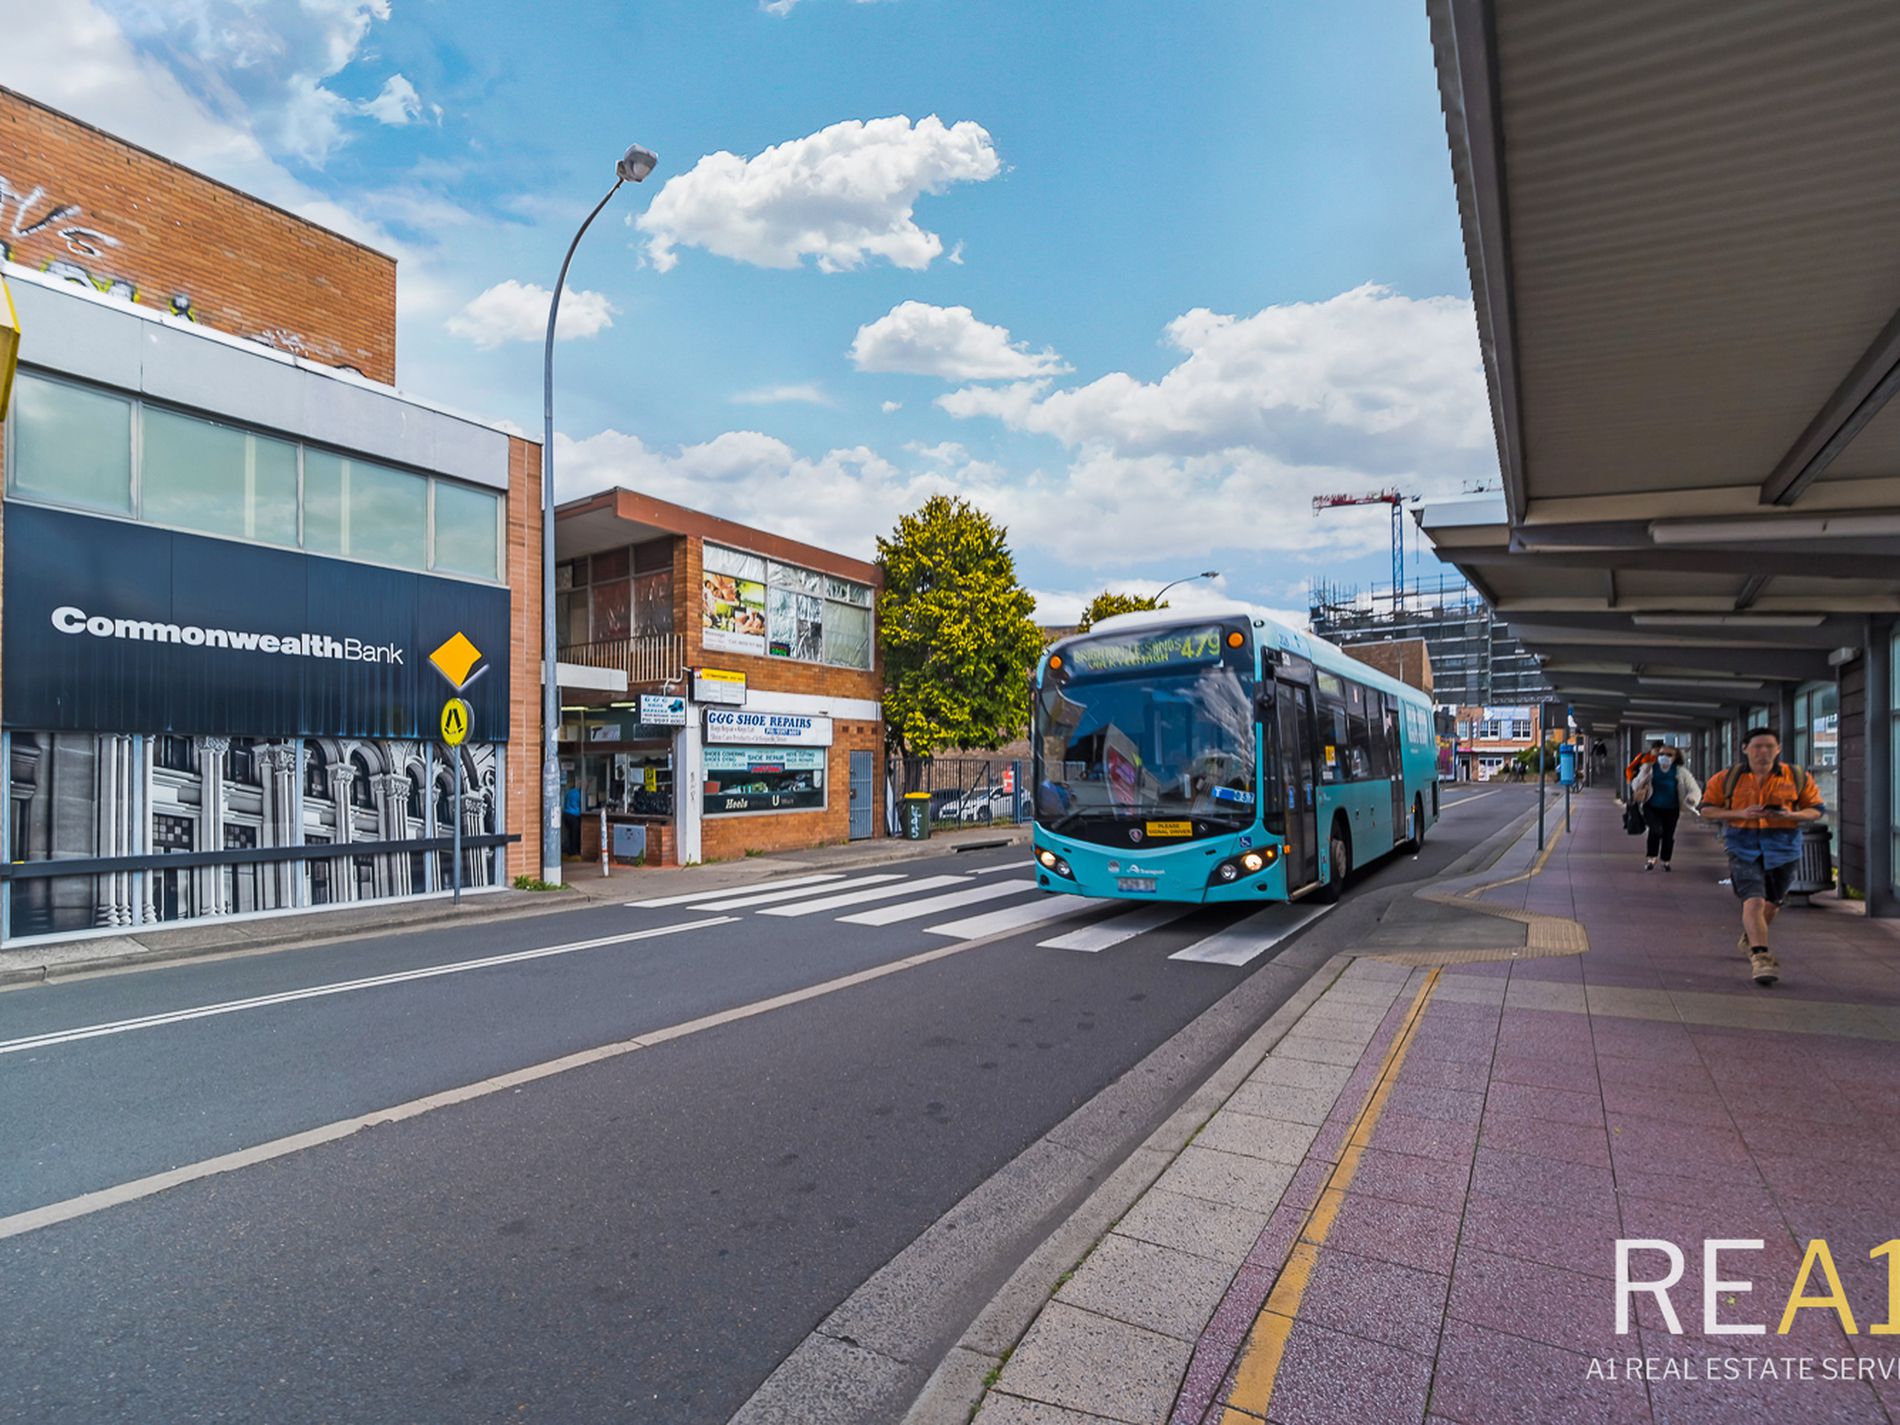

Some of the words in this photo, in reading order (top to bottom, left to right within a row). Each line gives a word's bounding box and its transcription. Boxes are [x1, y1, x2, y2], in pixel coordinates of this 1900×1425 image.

[1181, 632, 1220, 658] 479
[736, 714, 766, 726] SHOE
[769, 716, 812, 728] REPAIRS
